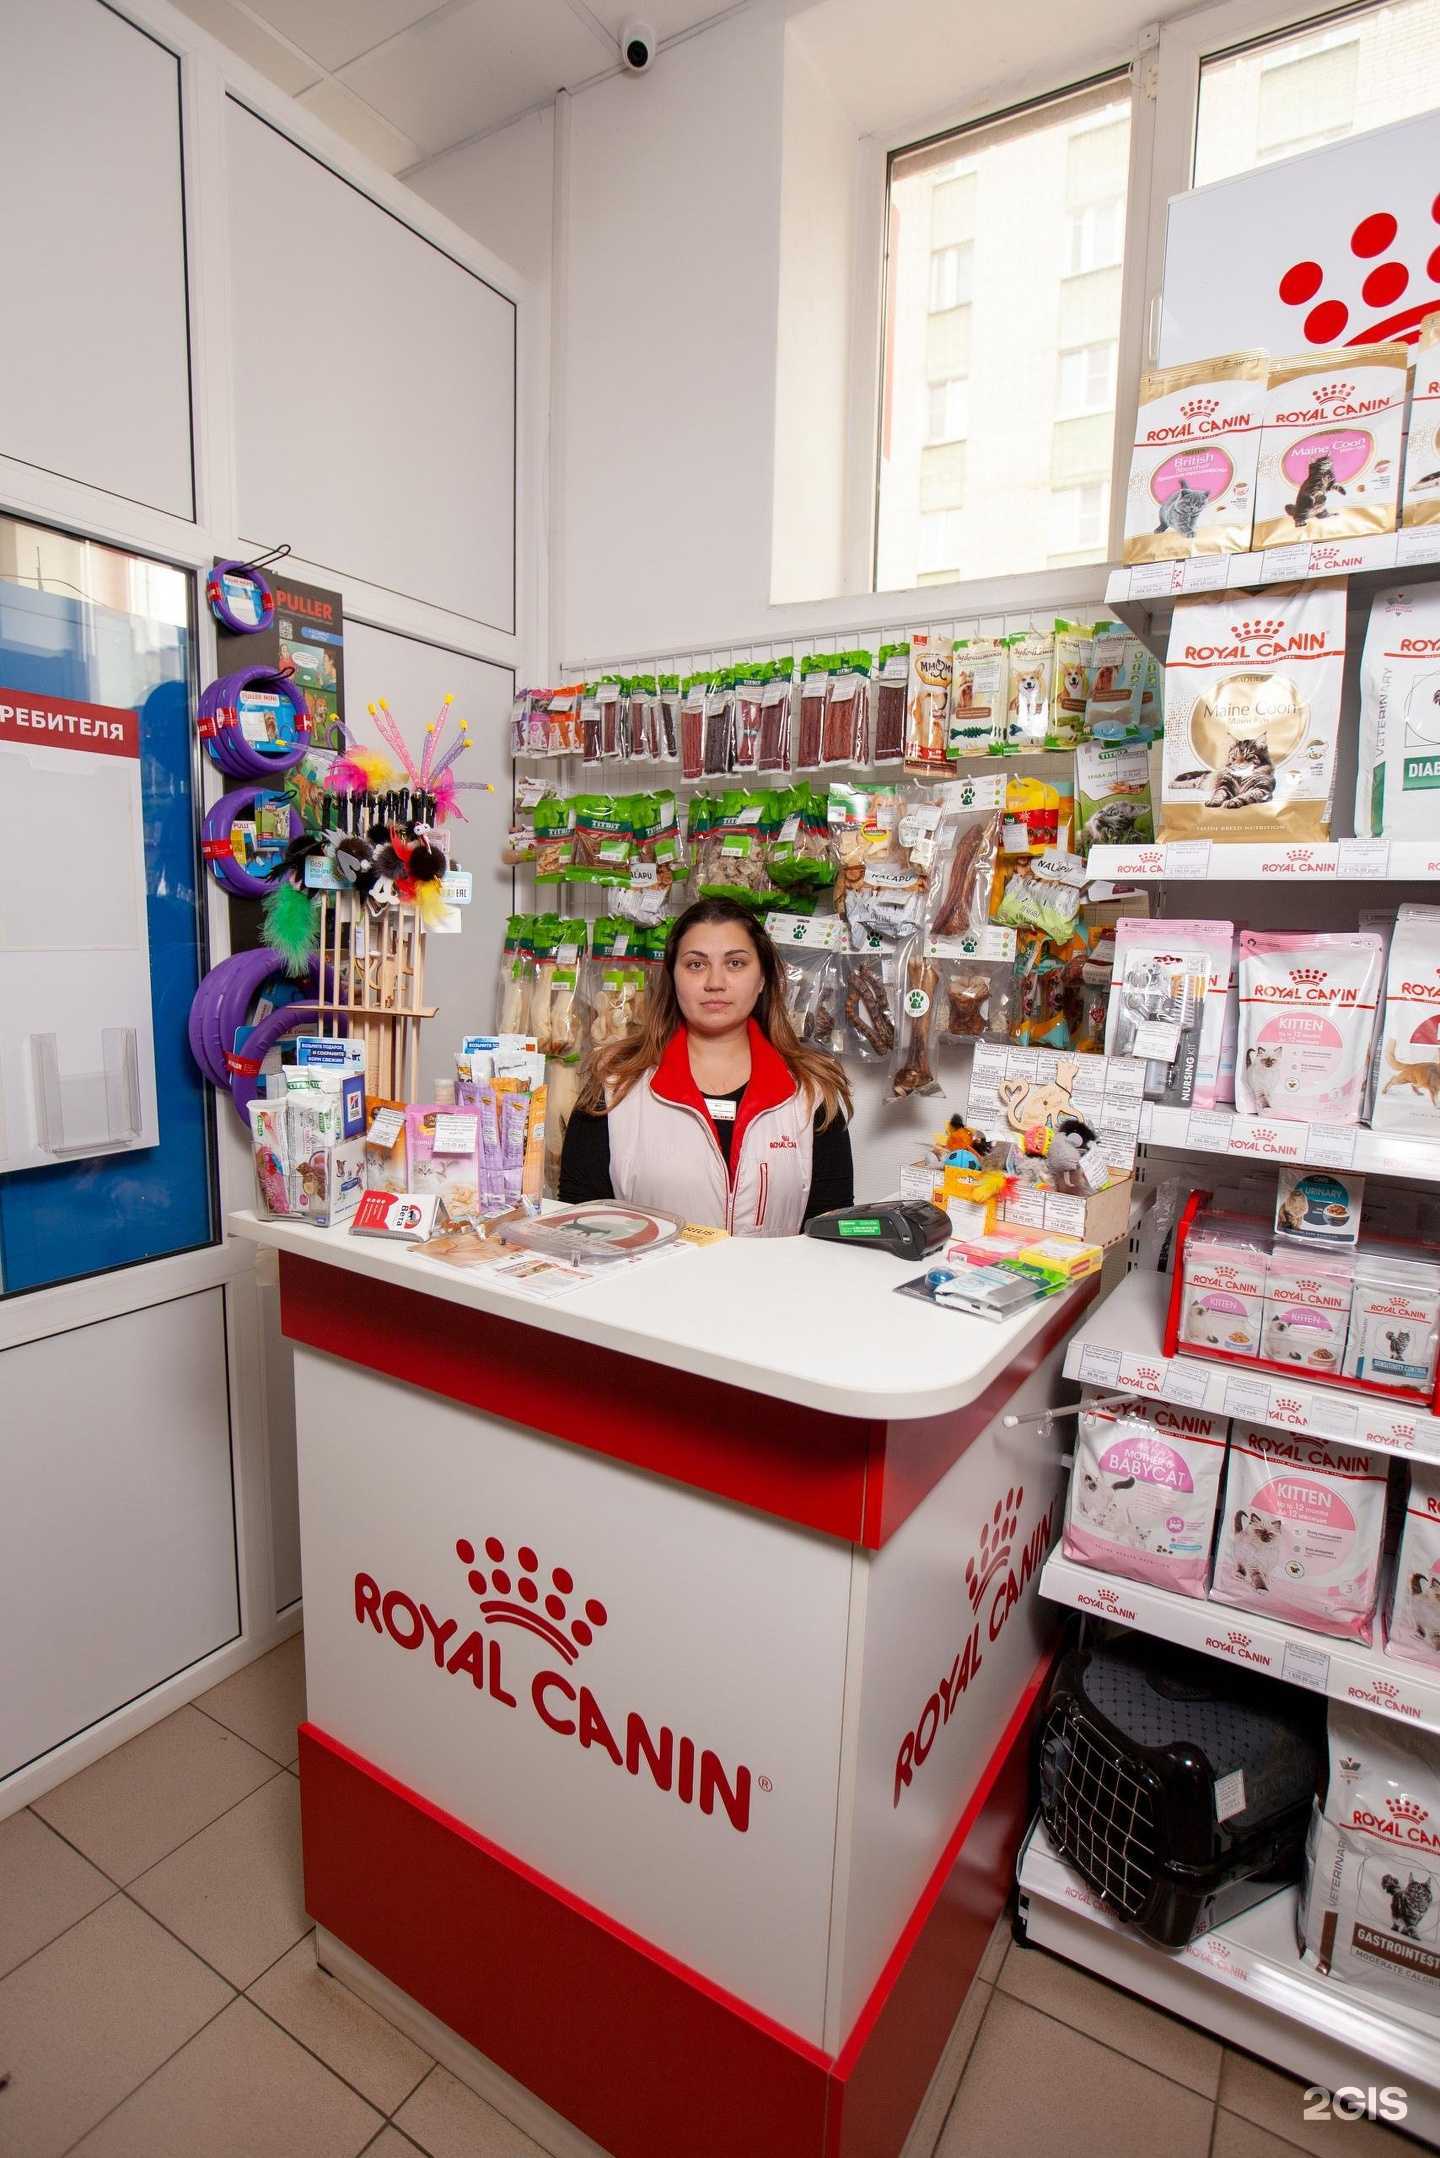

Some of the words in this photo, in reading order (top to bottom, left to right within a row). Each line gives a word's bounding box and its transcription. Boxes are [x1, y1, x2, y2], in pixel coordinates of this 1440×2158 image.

[1275, 409, 1329, 423] ROYAL
[1332, 397, 1390, 417] CANIN
[1147, 423, 1195, 441] ROYAL
[1198, 414, 1251, 433] CANIN
[1291, 446, 1329, 457] Maine
[1332, 437, 1366, 449] Coon
[1174, 453, 1214, 468] British
[1324, 557, 1363, 569] CANIN
[276, 590, 333, 619] PULLER
[1185, 646, 1250, 660] ROYAL
[1256, 632, 1325, 657] CANIN
[1203, 704, 1250, 719] Maine
[1255, 703, 1297, 716] Coon
[0, 704, 125, 741] РЕБИТЕЛЯ
[591, 820, 620, 830] TITBIT
[1117, 864, 1147, 873] ROYAL
[1261, 863, 1297, 872] ROYAL
[1299, 863, 1336, 872] CANIN
[1254, 984, 1301, 999] ROYAL
[1306, 988, 1357, 1002] CANIN
[1279, 1018, 1324, 1031] KITTEN
[1181, 1057, 1195, 1101] NURSING
[1263, 1143, 1297, 1156] CANIN
[1304, 1187, 1343, 1198] URINARY
[1193, 1274, 1223, 1288] ROYAL
[1225, 1280, 1257, 1293] CANIN
[1274, 1289, 1305, 1301] ROYAL
[1307, 1295, 1342, 1307] CANIN
[1370, 1304, 1397, 1315] ROYAL
[1398, 1308, 1426, 1320] CANIN
[1154, 1410, 1212, 1435] CANIN
[1366, 1432, 1399, 1446] ROYAL
[1124, 1449, 1164, 1464] MOTHER
[1248, 1433, 1303, 1462] ROYAL
[1308, 1451, 1369, 1473] CANIN
[1109, 1454, 1185, 1486] BABYCAT
[1278, 1483, 1332, 1508] KITTEN
[1077, 1594, 1105, 1611] ROYAL
[1106, 1604, 1136, 1620] CANIN
[893, 1622, 983, 1809] ROYAL
[989, 1501, 1053, 1642] CANIN
[1205, 1637, 1236, 1655] ROYAL
[1238, 1649, 1270, 1666] CANIN
[354, 1572, 517, 1708] ROYAL
[531, 1671, 752, 1832] CANIN
[1348, 1687, 1381, 1705] ROYAL
[1384, 1699, 1421, 1718] CANIN
[1353, 1810, 1403, 1838] ROYAL
[1065, 1886, 1091, 1906] ROYAL
[1217, 1960, 1248, 1981] CANIN
